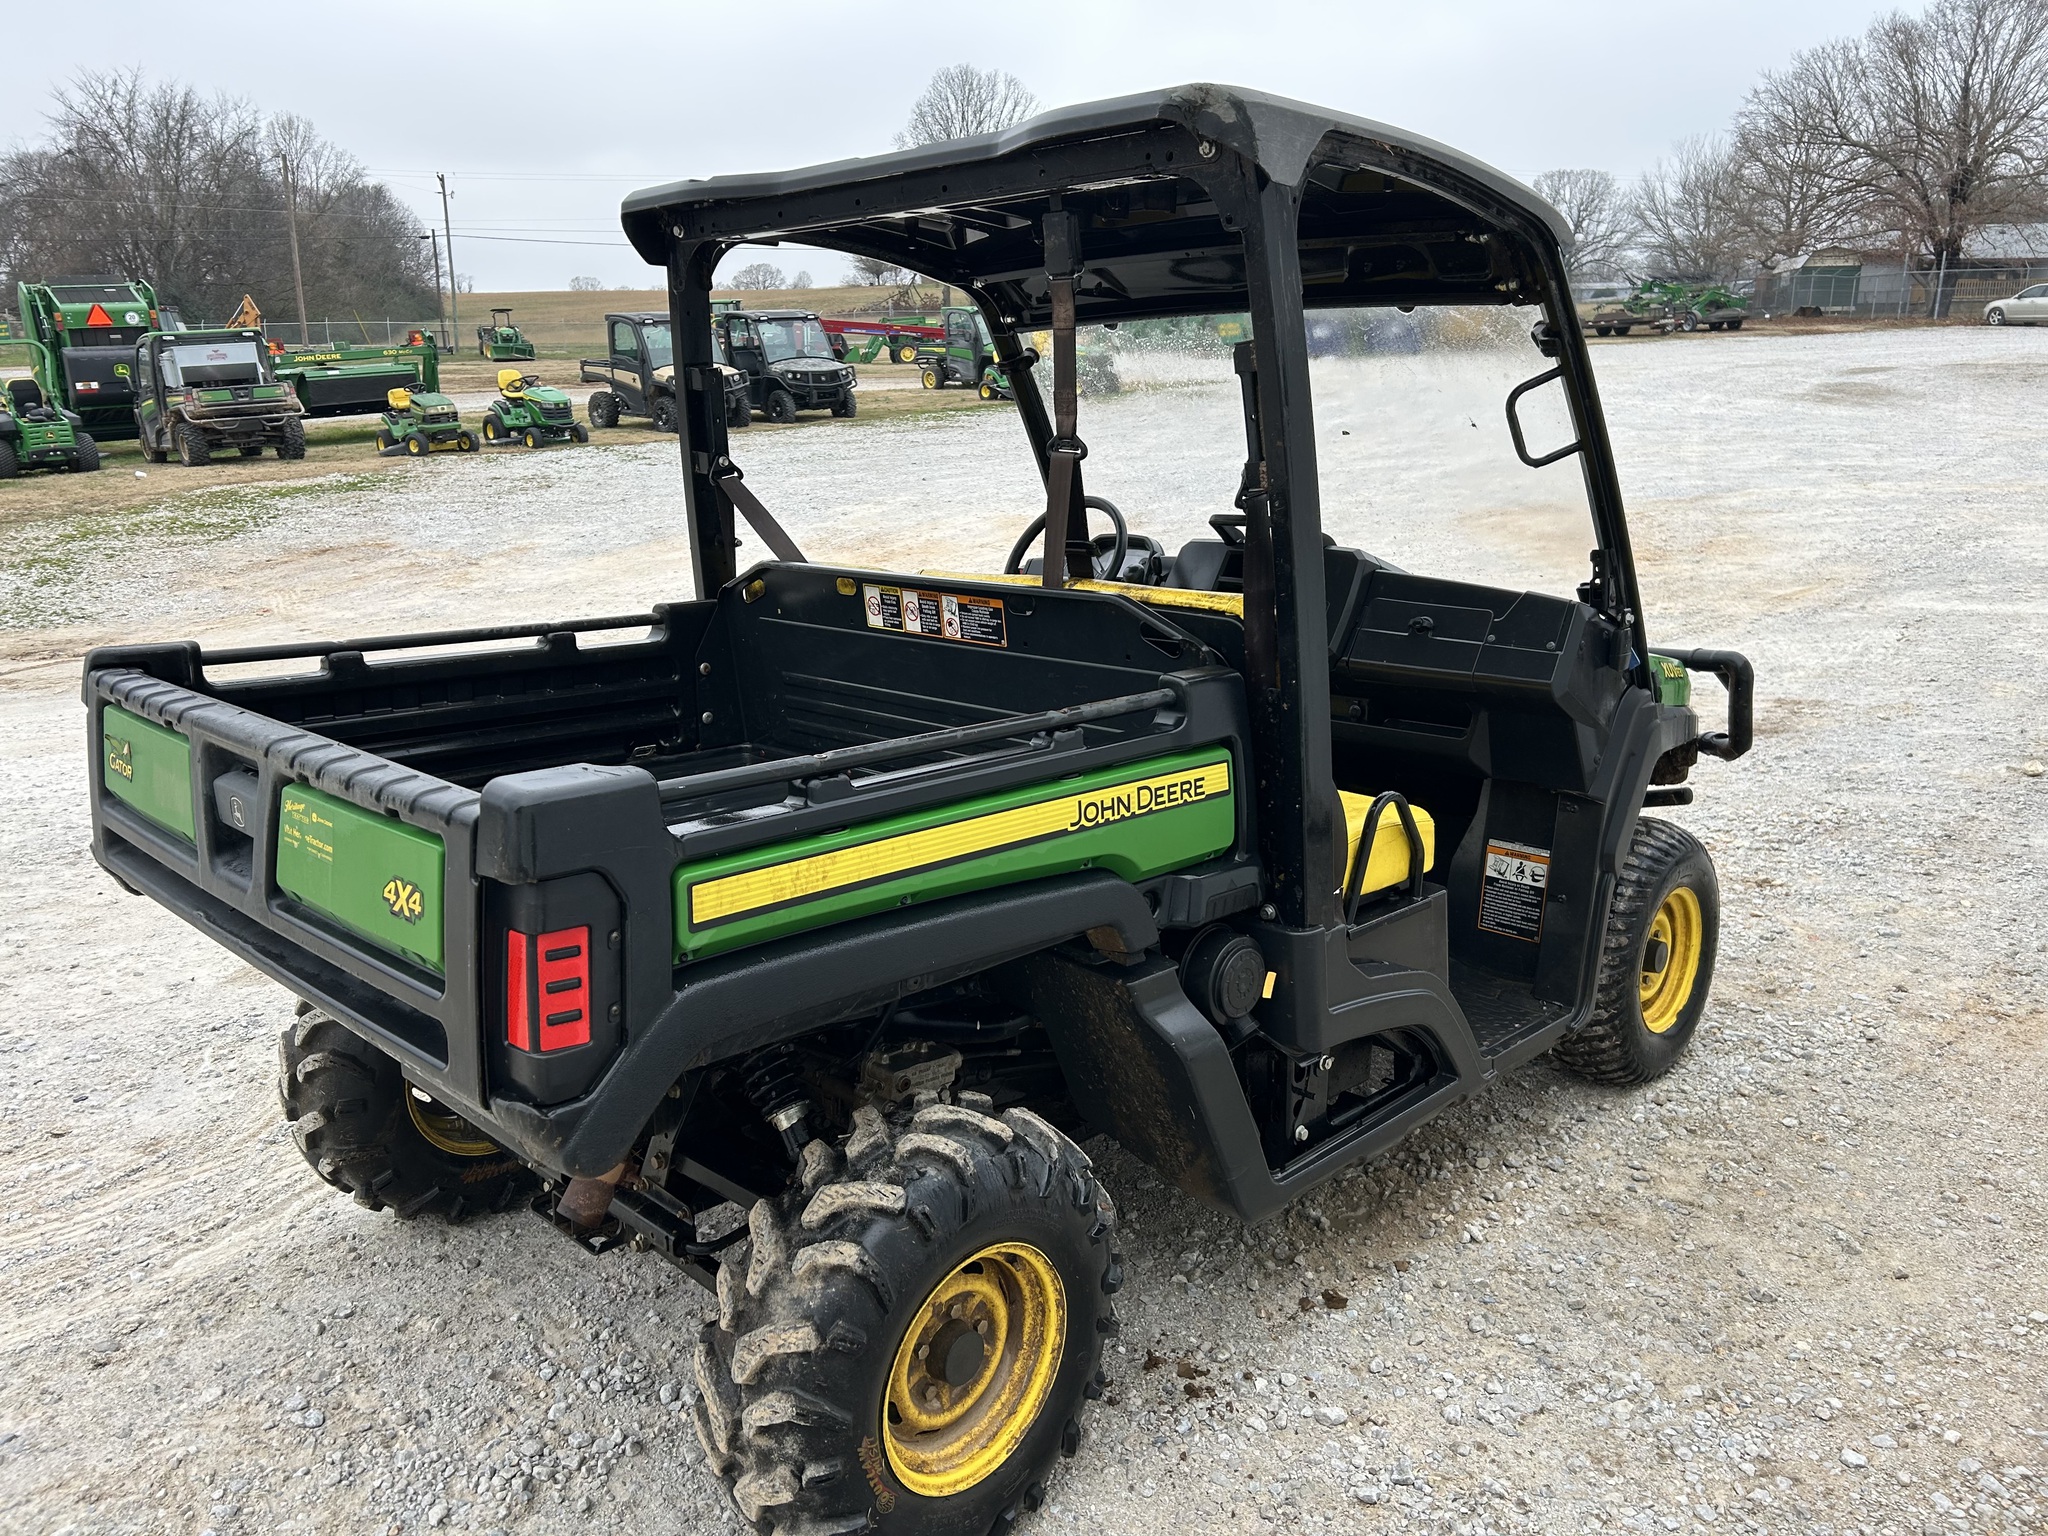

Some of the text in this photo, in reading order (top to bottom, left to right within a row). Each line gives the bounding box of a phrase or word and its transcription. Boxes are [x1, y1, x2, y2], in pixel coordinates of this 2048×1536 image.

[294, 353, 342, 362] JOHN DEERE
[109, 752, 133, 780] GATOR
[1070, 777, 1206, 828] JOHN DEERE
[1509, 851, 1531, 860] WARNING
[856, 1447, 891, 1504] OUTLAW
